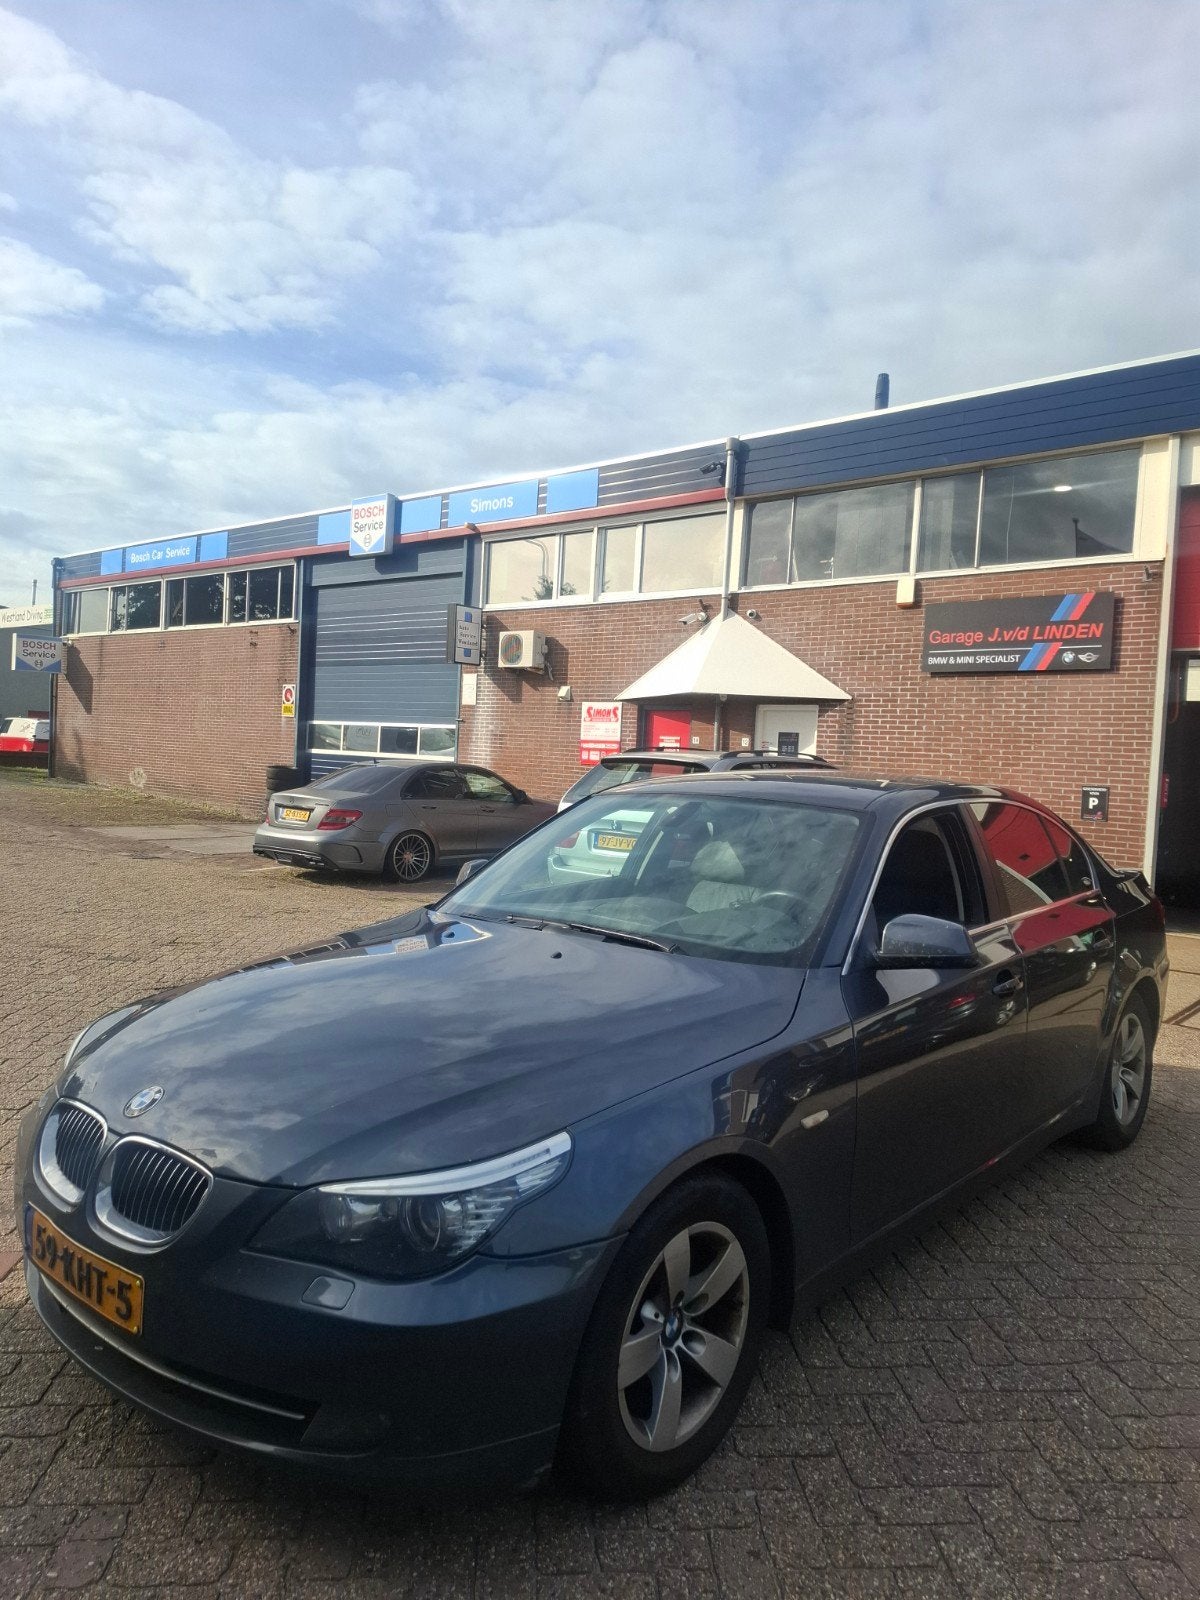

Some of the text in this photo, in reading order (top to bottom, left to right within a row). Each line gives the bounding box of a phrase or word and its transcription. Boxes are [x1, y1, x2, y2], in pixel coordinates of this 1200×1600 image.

[470, 496, 514, 514] Simons
[353, 505, 385, 520] BOSCH
[353, 520, 384, 533] Service
[130, 547, 190, 564] Bosch Car Service
[928, 623, 1104, 646] Garage J.v/d LINDEN
[22, 640, 57, 650] BOSCH
[22, 649, 56, 659] Service
[928, 656, 950, 665] BMW
[956, 656, 974, 664] MINI
[975, 654, 1020, 664] SPECIALIST
[1088, 797, 1099, 809] P
[35, 1223, 133, 1321] 59-KHT-5
